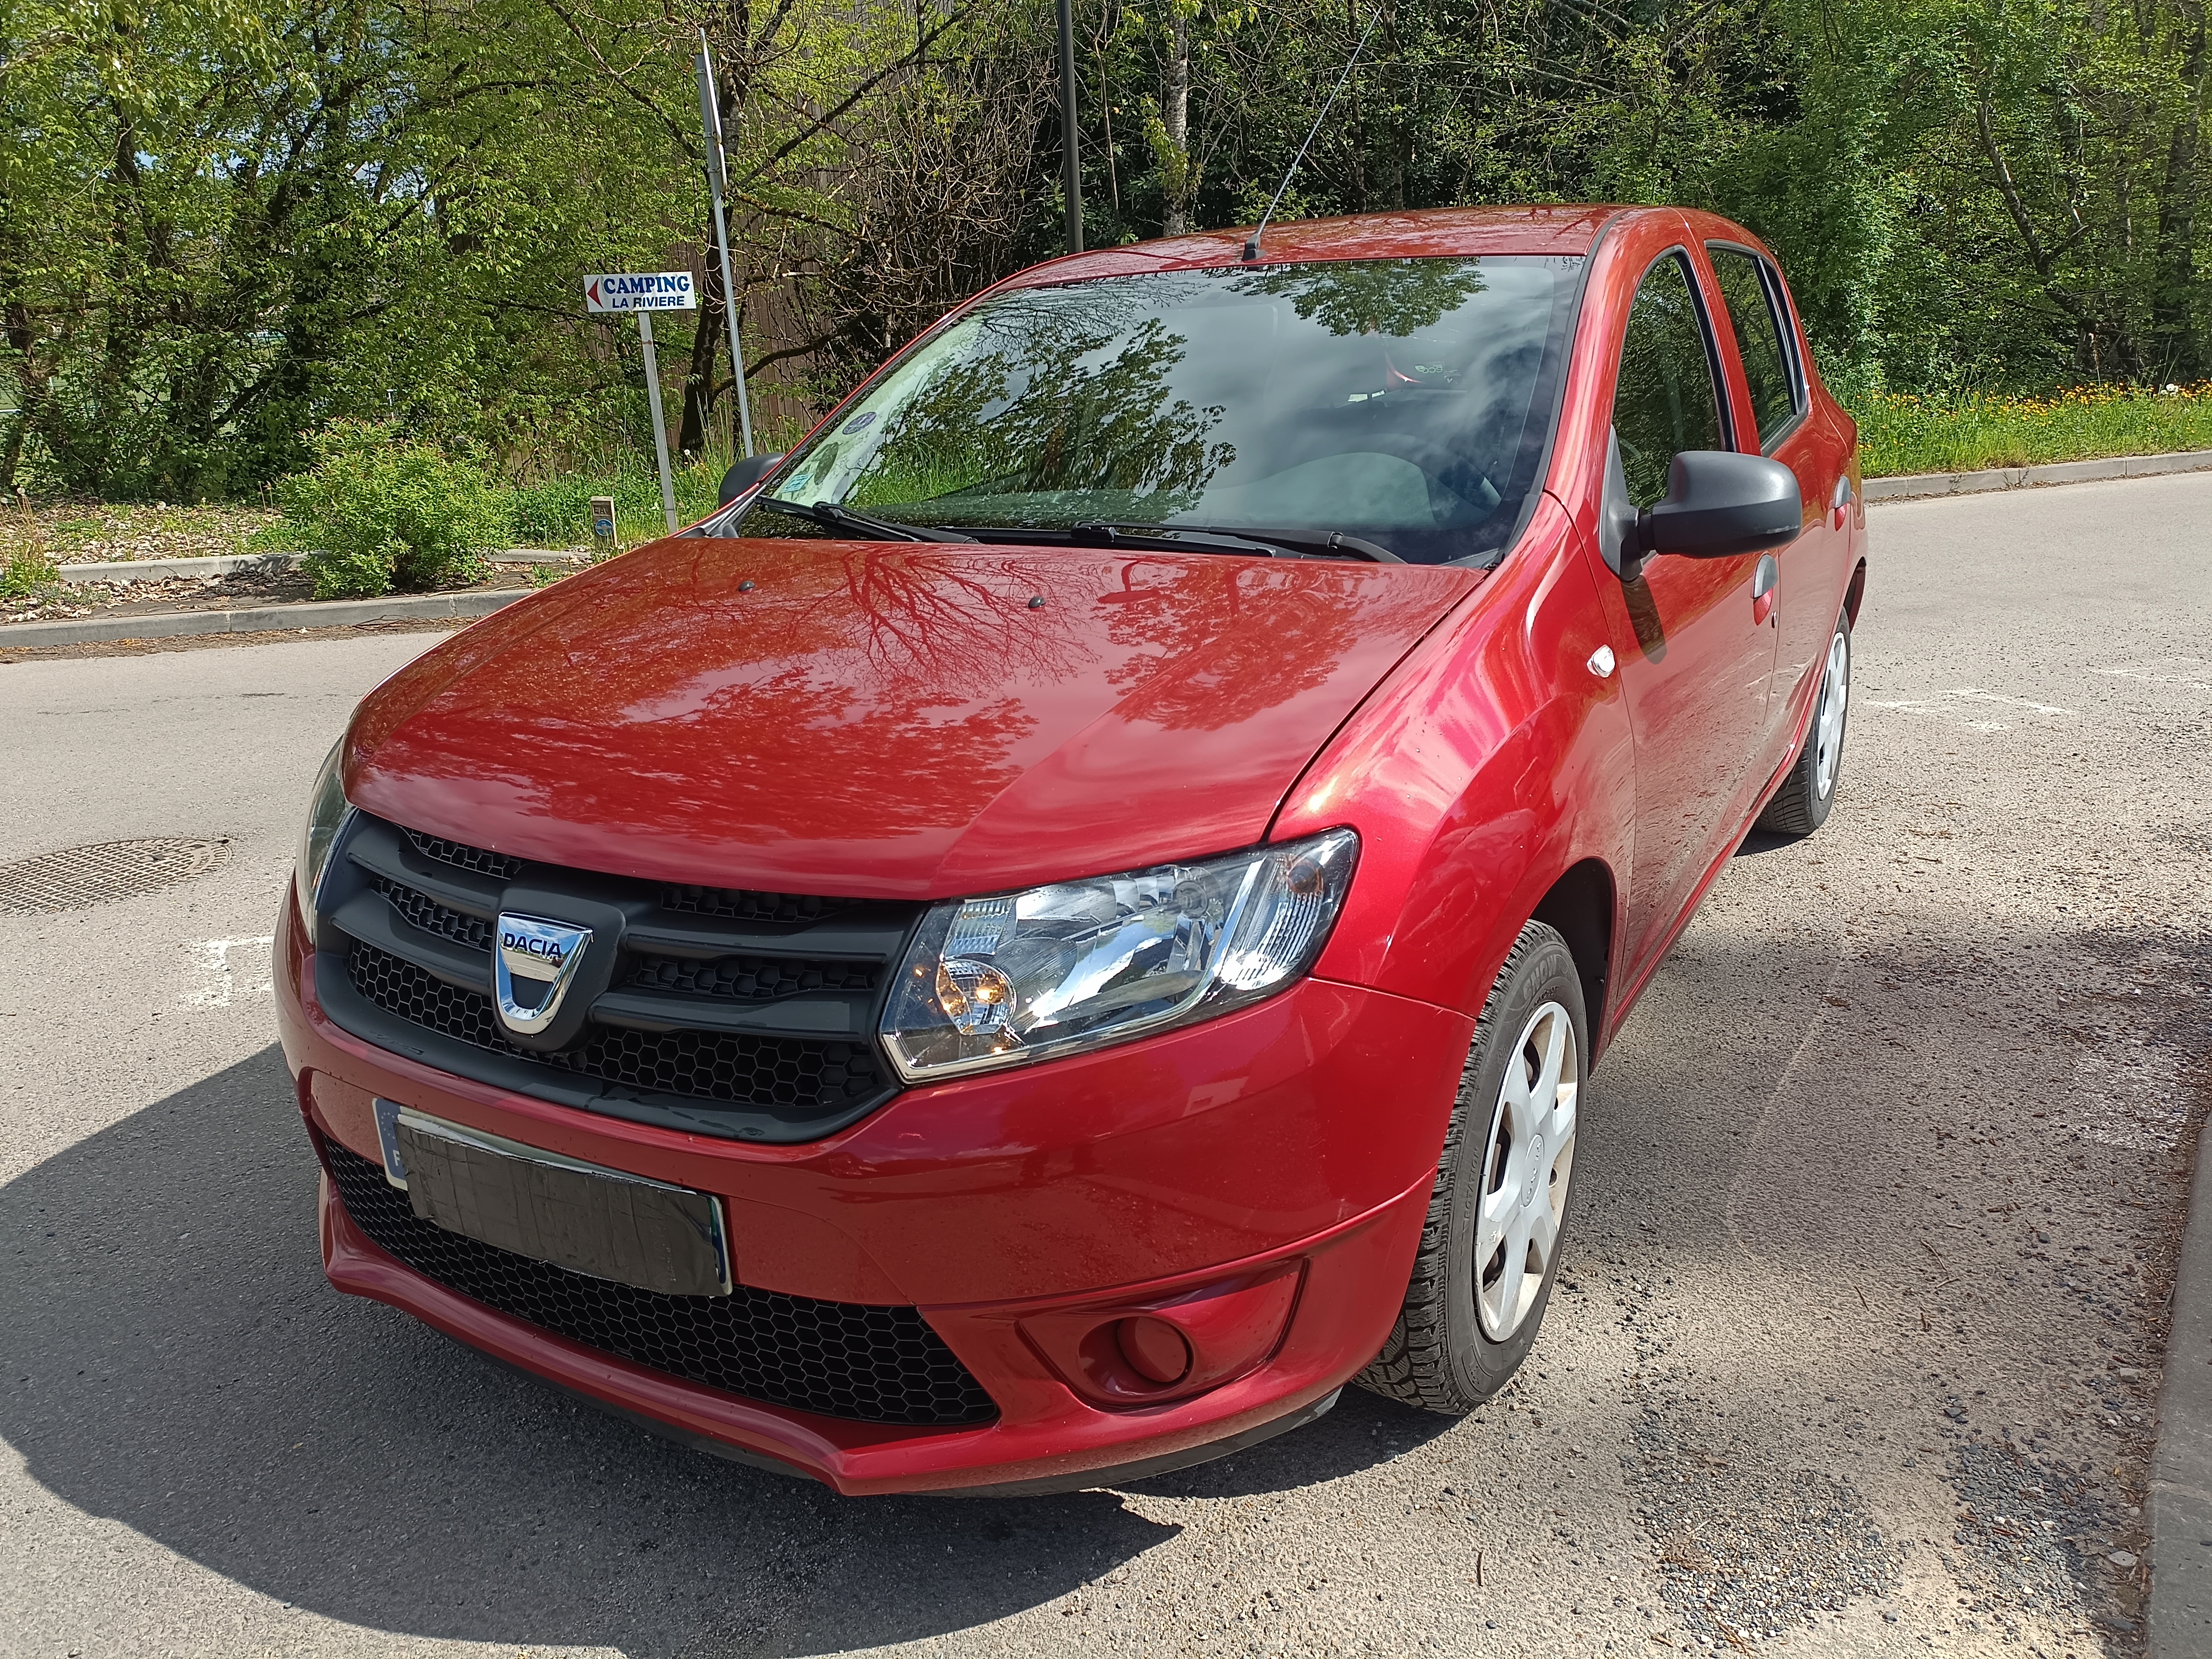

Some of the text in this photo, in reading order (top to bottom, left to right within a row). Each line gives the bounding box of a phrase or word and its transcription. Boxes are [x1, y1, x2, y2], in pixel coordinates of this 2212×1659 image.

[603, 276, 690, 294] CAMPING
[612, 296, 685, 308] LA RIVIERE
[504, 933, 562, 959] DACIA
[1523, 954, 1557, 1001] SNOW
[393, 1149, 400, 1166] F
[1464, 1146, 1480, 1221] ROTATION
